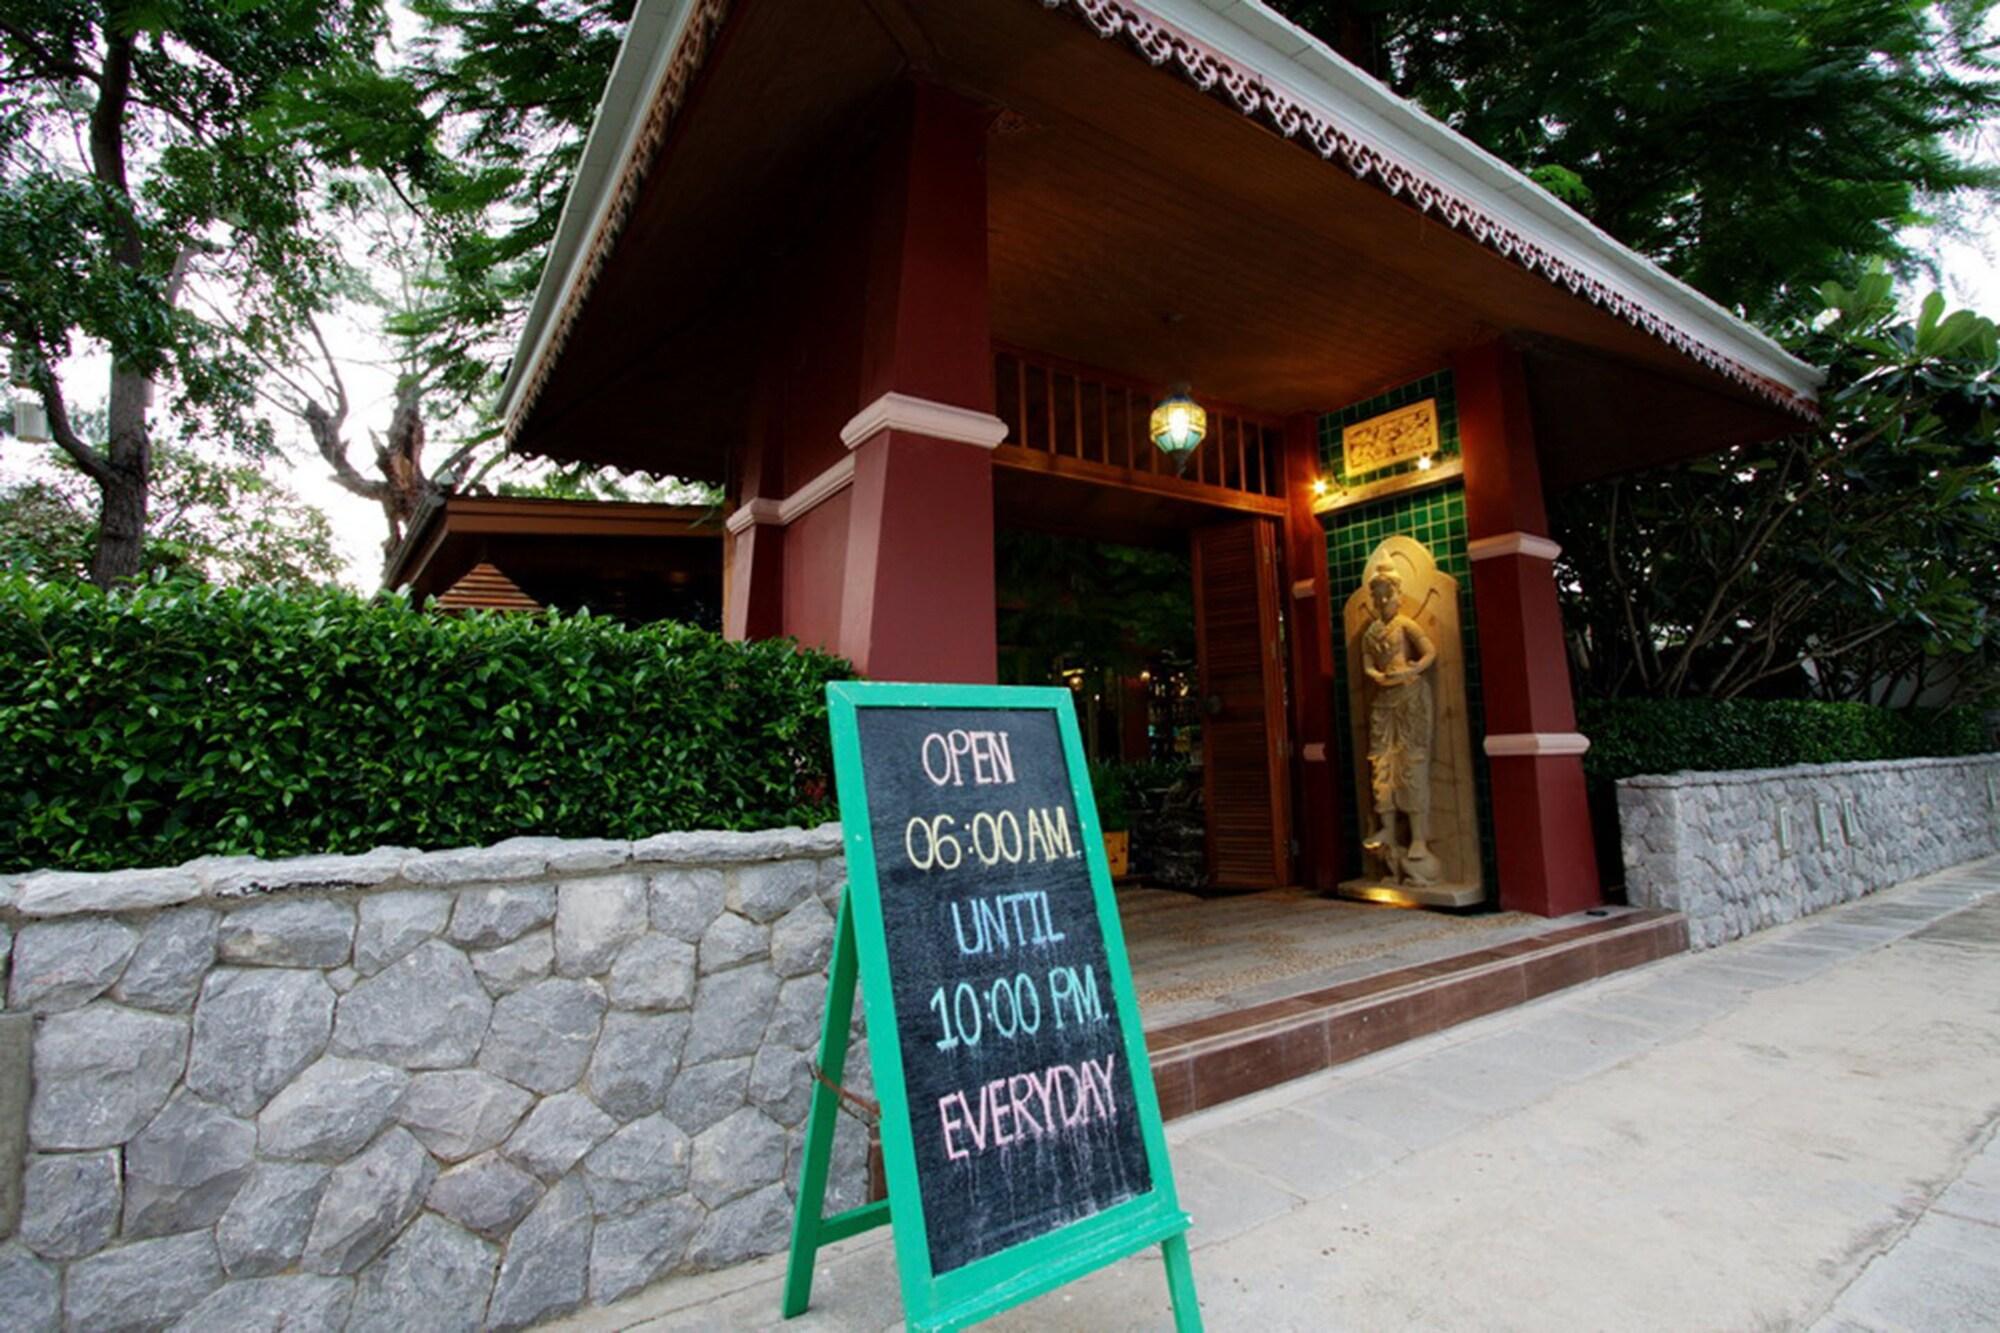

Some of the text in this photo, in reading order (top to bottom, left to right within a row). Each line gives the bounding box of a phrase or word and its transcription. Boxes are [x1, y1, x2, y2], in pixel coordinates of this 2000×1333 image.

[921, 729, 1016, 786] OPEN
[905, 810, 1023, 870] 06:00
[951, 890, 1065, 954] UNTIL
[929, 972, 1041, 1051] 10:00
[938, 1054, 1116, 1160] EVERYDAY
